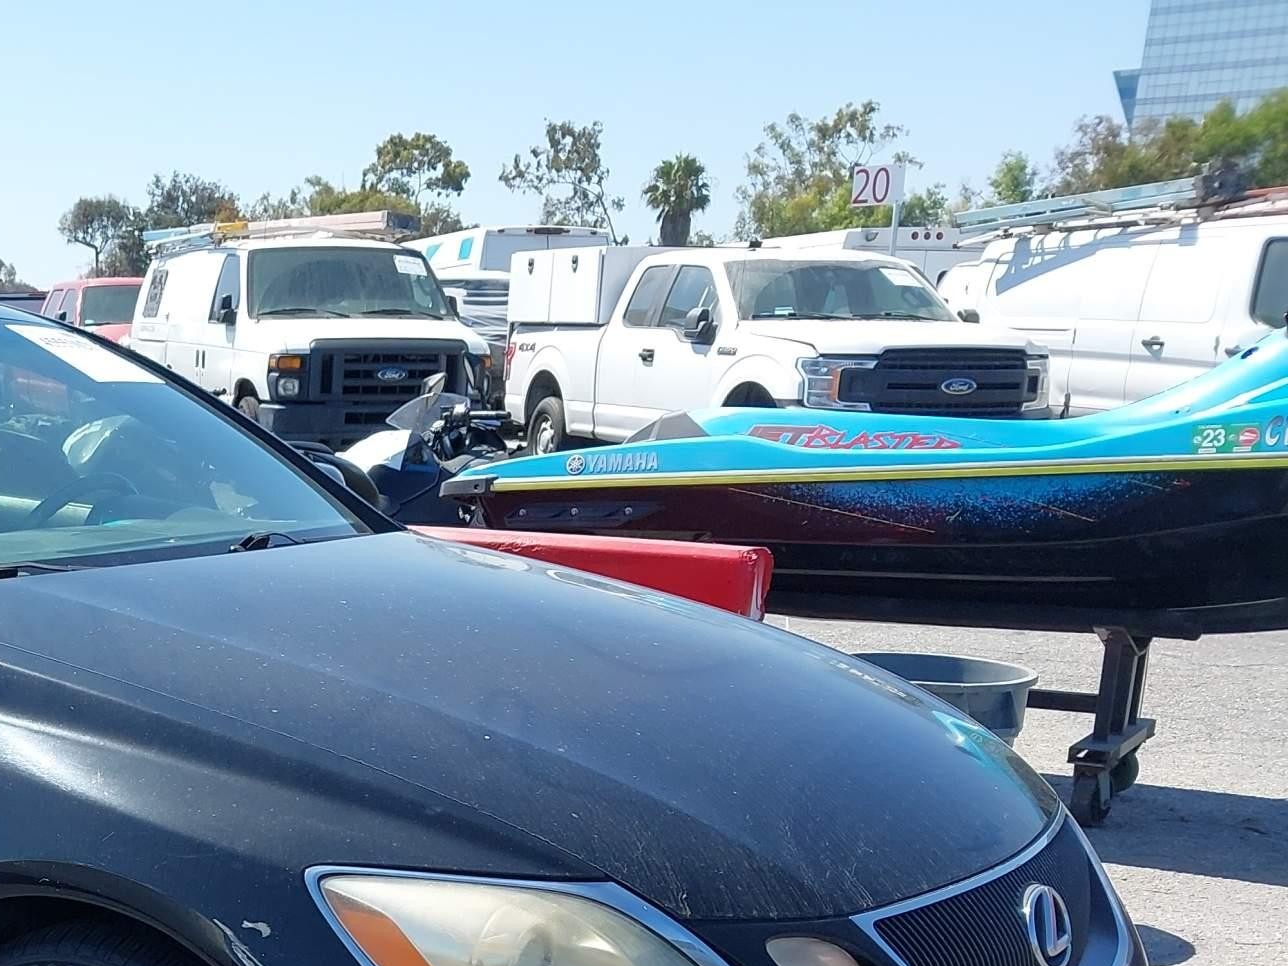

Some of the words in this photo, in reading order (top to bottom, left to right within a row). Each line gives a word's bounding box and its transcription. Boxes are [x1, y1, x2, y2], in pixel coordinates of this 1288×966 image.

[852, 167, 890, 204] 20
[1202, 428, 1226, 447] 23
[1265, 415, 1288, 446] C
[586, 452, 659, 473] YAMAHA
